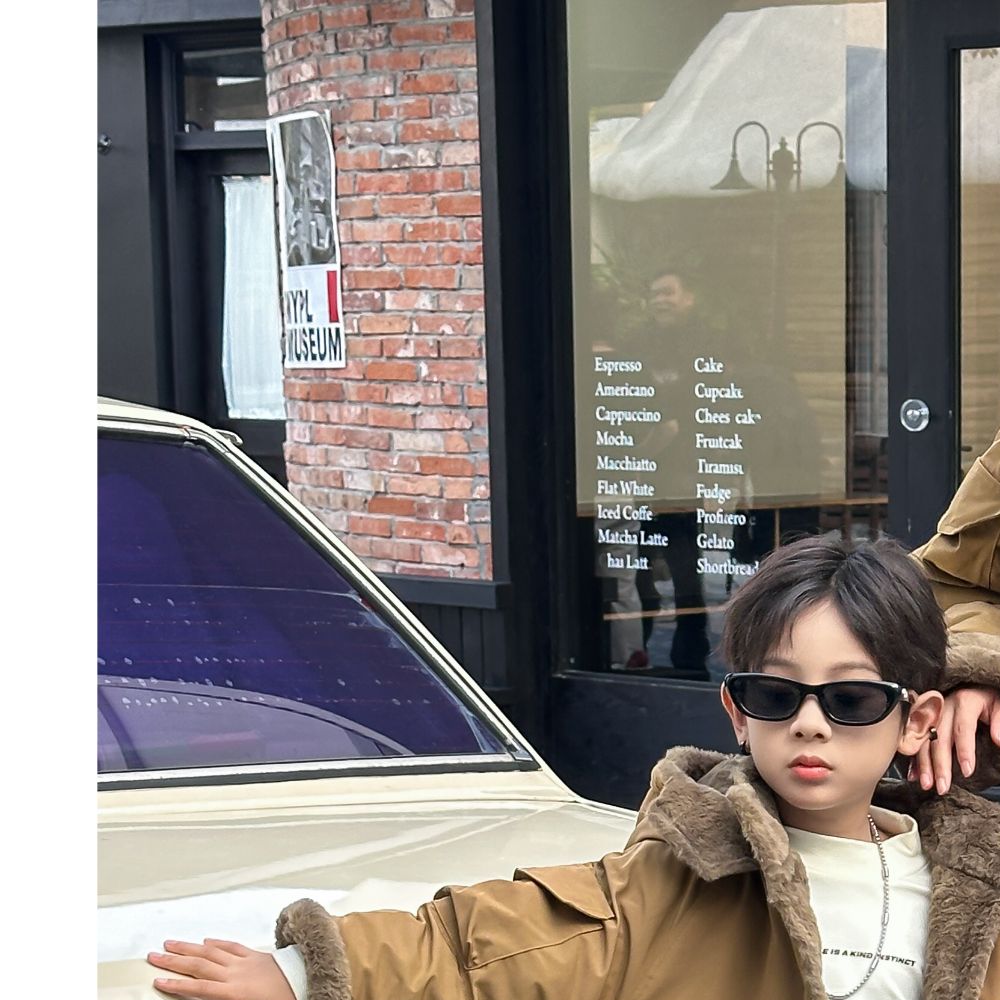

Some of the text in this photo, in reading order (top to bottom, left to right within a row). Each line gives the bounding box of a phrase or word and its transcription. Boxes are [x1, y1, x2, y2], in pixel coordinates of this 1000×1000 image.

[594, 356, 643, 377] Espresso
[694, 356, 724, 373] Cake
[594, 381, 655, 398] Americano
[595, 405, 662, 426] Cappuccino
[596, 430, 634, 447] Mocha
[596, 454, 658, 472] Macchiatto
[597, 480, 655, 497] Flat White
[696, 482, 732, 505] Fudge
[597, 503, 654, 521] Iced Coffe
[597, 528, 670, 547] Matcha Latte
[696, 532, 735, 550] Gelato
[830, 948, 841, 956] IS
[849, 951, 873, 959] KIND
[877, 954, 916, 967] NSTINCT
